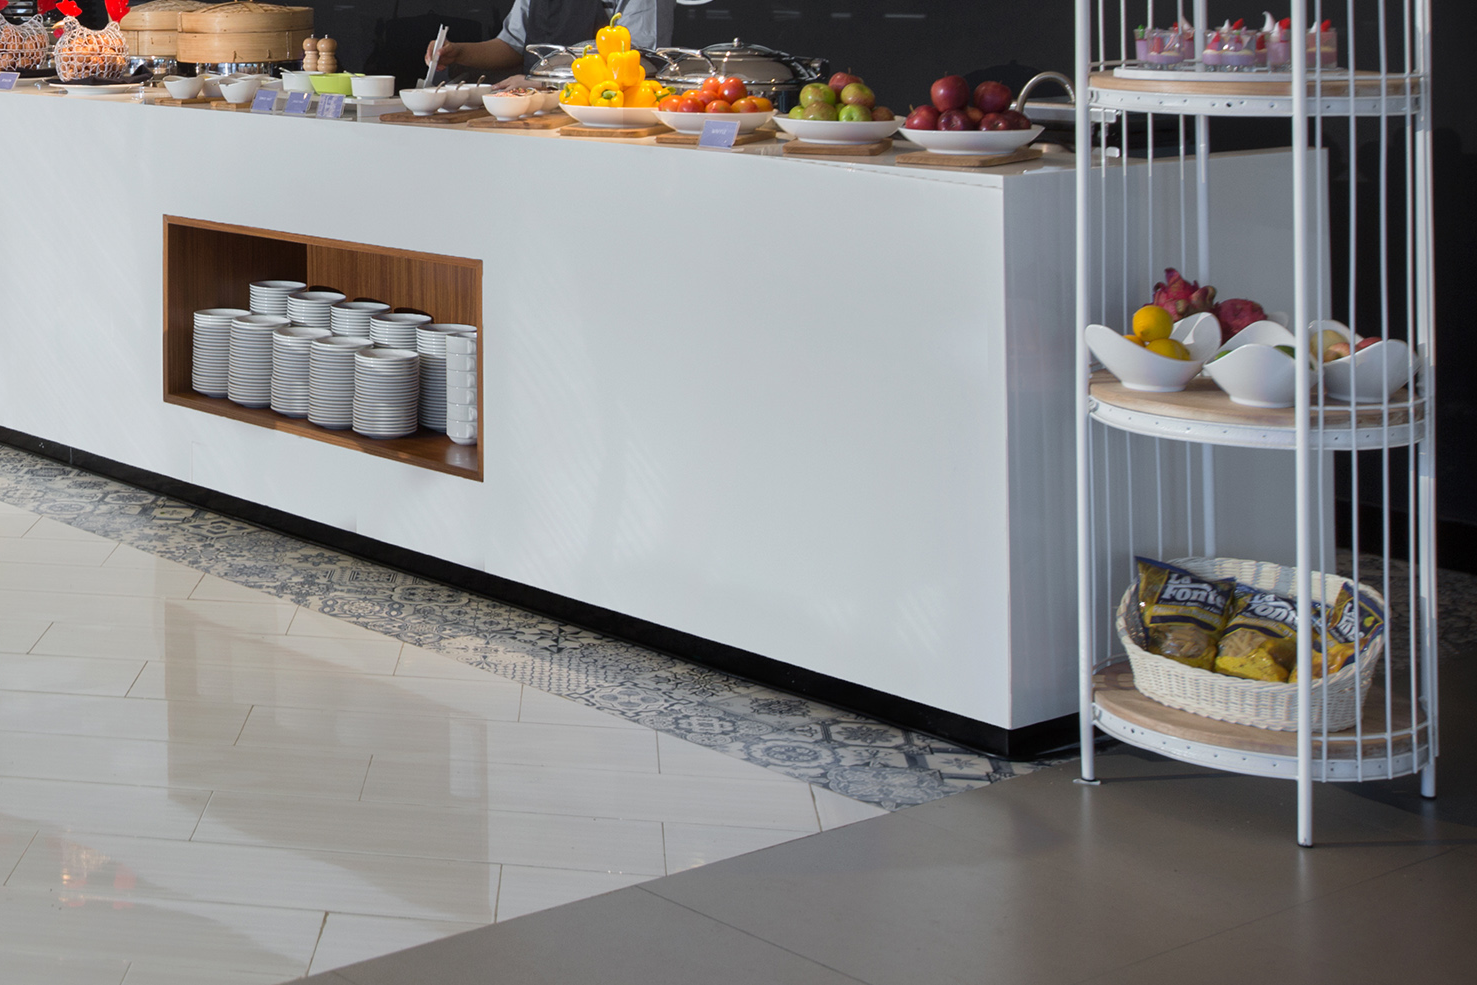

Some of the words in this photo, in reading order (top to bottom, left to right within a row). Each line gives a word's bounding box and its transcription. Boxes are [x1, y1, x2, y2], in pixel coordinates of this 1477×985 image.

[1167, 573, 1192, 584] La
[1161, 583, 1225, 608] Fonte
[1249, 593, 1275, 604] La
